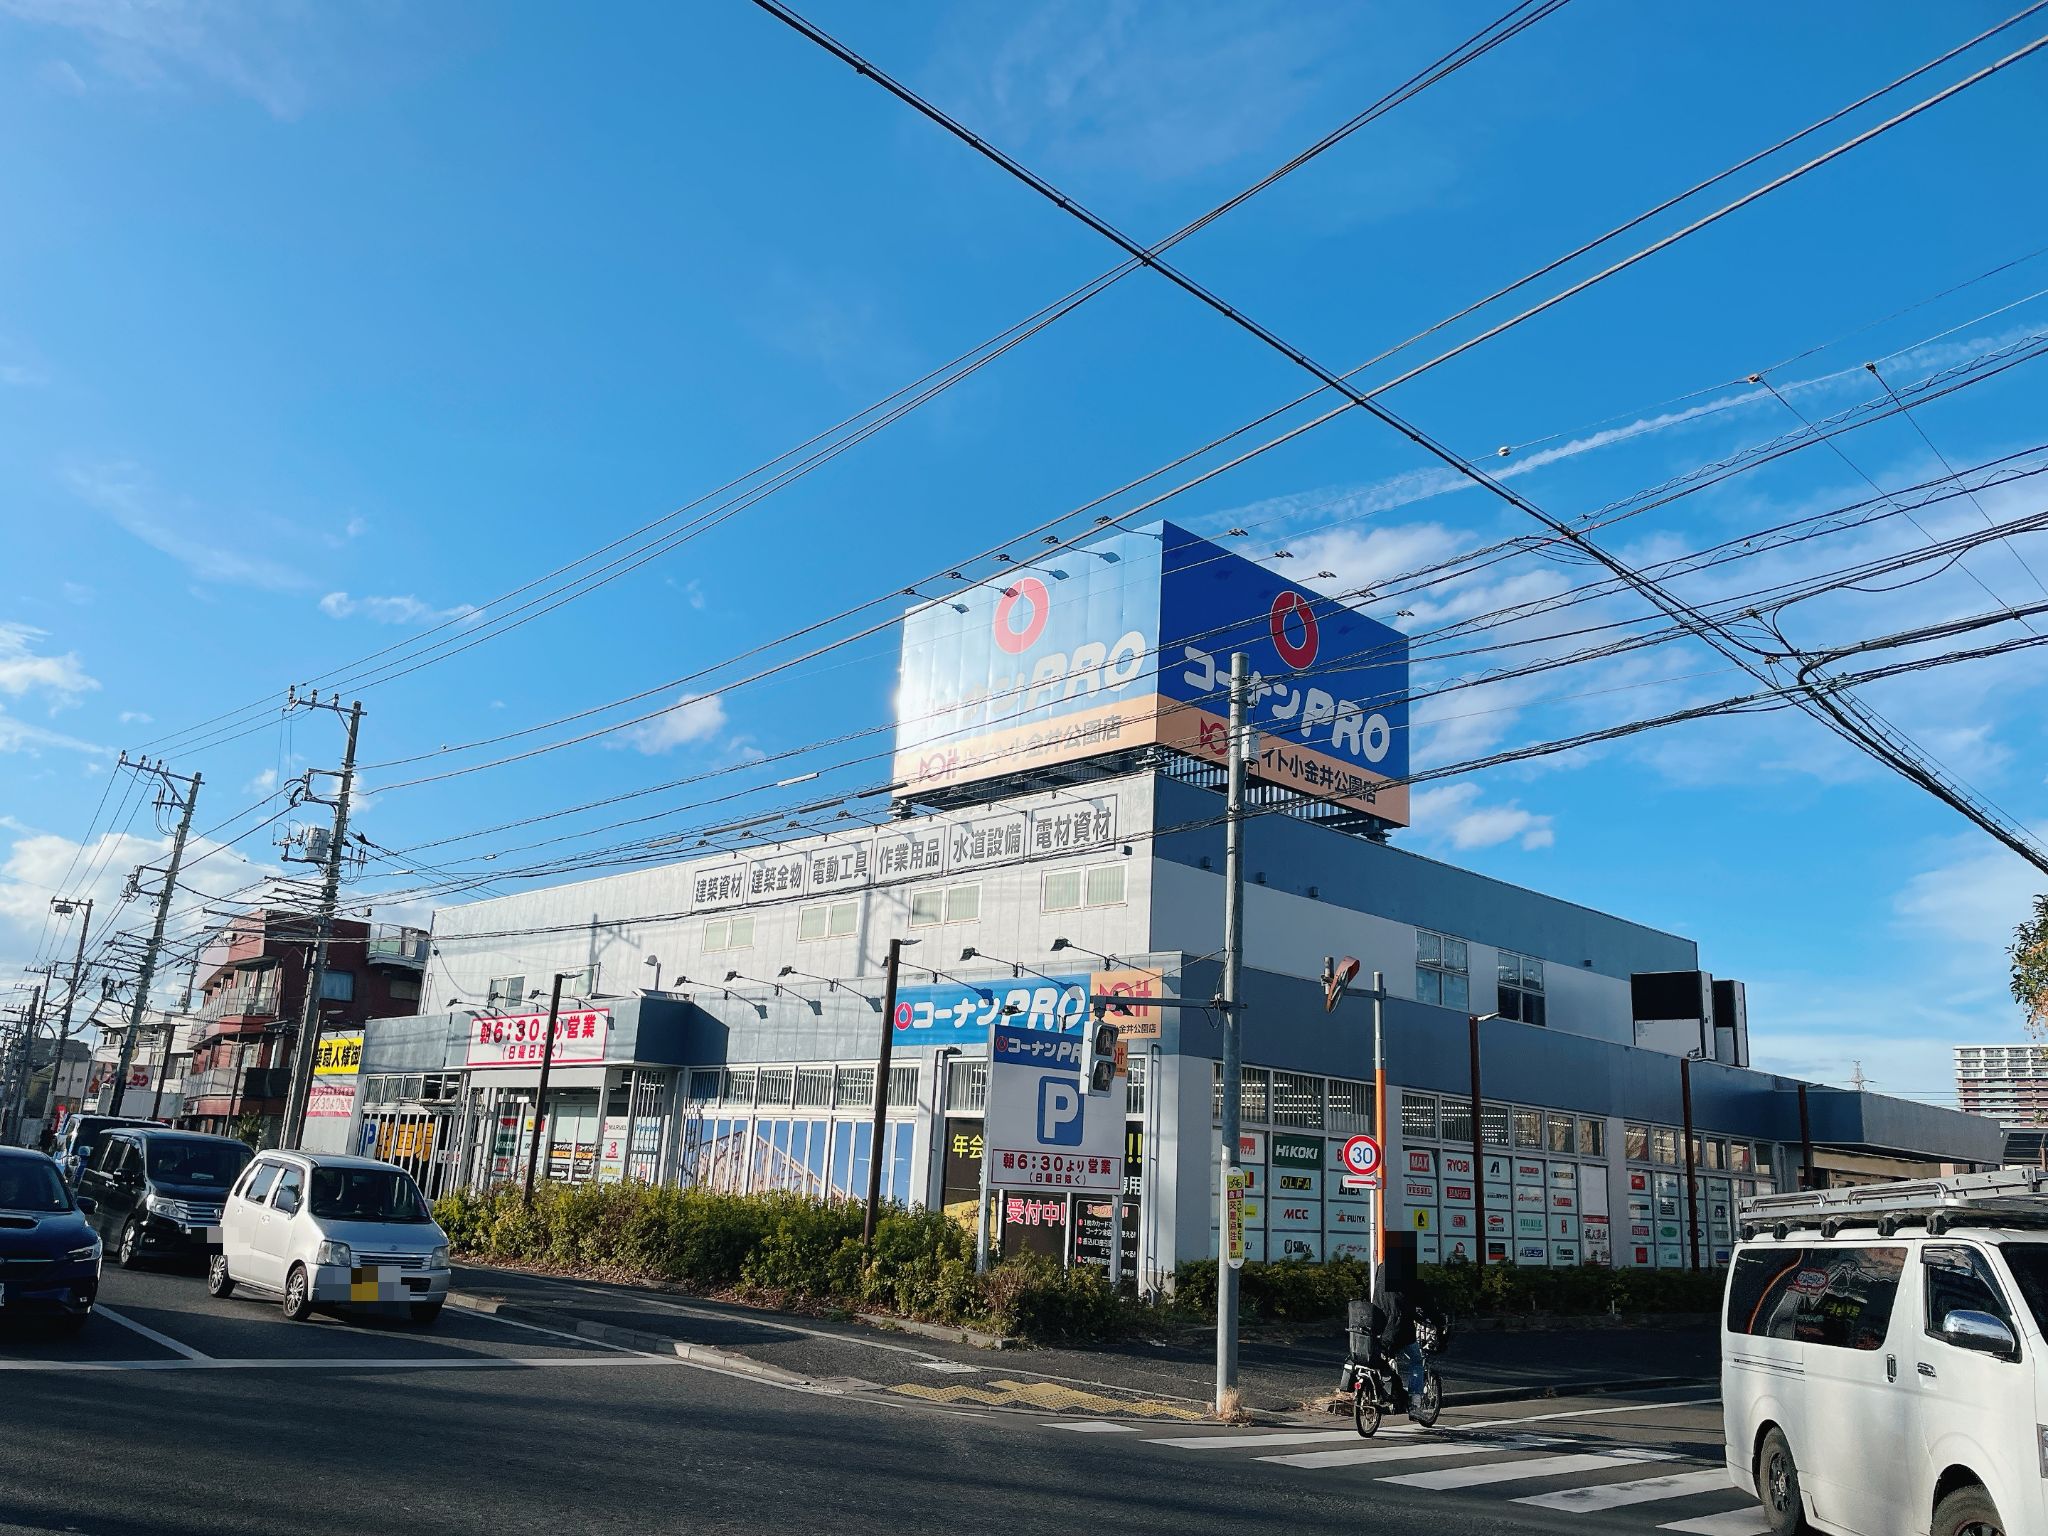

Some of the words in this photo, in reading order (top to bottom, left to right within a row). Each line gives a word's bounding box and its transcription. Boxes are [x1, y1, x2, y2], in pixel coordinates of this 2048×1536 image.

[1184, 646, 1390, 763] コーナンPRO
[1261, 748, 1377, 805] イト小金井公園店
[952, 822, 1022, 863] 水道設備
[1035, 806, 1112, 849] 電材資材
[812, 849, 868, 885] 電動工具
[879, 837, 941, 876] 作業用品
[694, 871, 743, 904] 建築資材
[751, 862, 803, 895] 建築金物
[912, 985, 1086, 1030] コーナンPRO
[480, 1014, 597, 1044] 朝6:30り営業
[1117, 1023, 1157, 1034] 金井公園店
[1008, 1037, 1082, 1064] コーナンPR
[1043, 1081, 1079, 1139] P
[1003, 1153, 1111, 1174] 朝6:30より営業
[1352, 1146, 1373, 1164] 30
[1411, 1154, 1429, 1169] MAX
[1446, 1158, 1470, 1173] RYOBI
[1029, 1172, 1086, 1185] (日曜日除く)
[1281, 1176, 1312, 1190] OLFA
[1006, 1197, 1066, 1227] 受付中!
[1283, 1208, 1309, 1219] MCC
